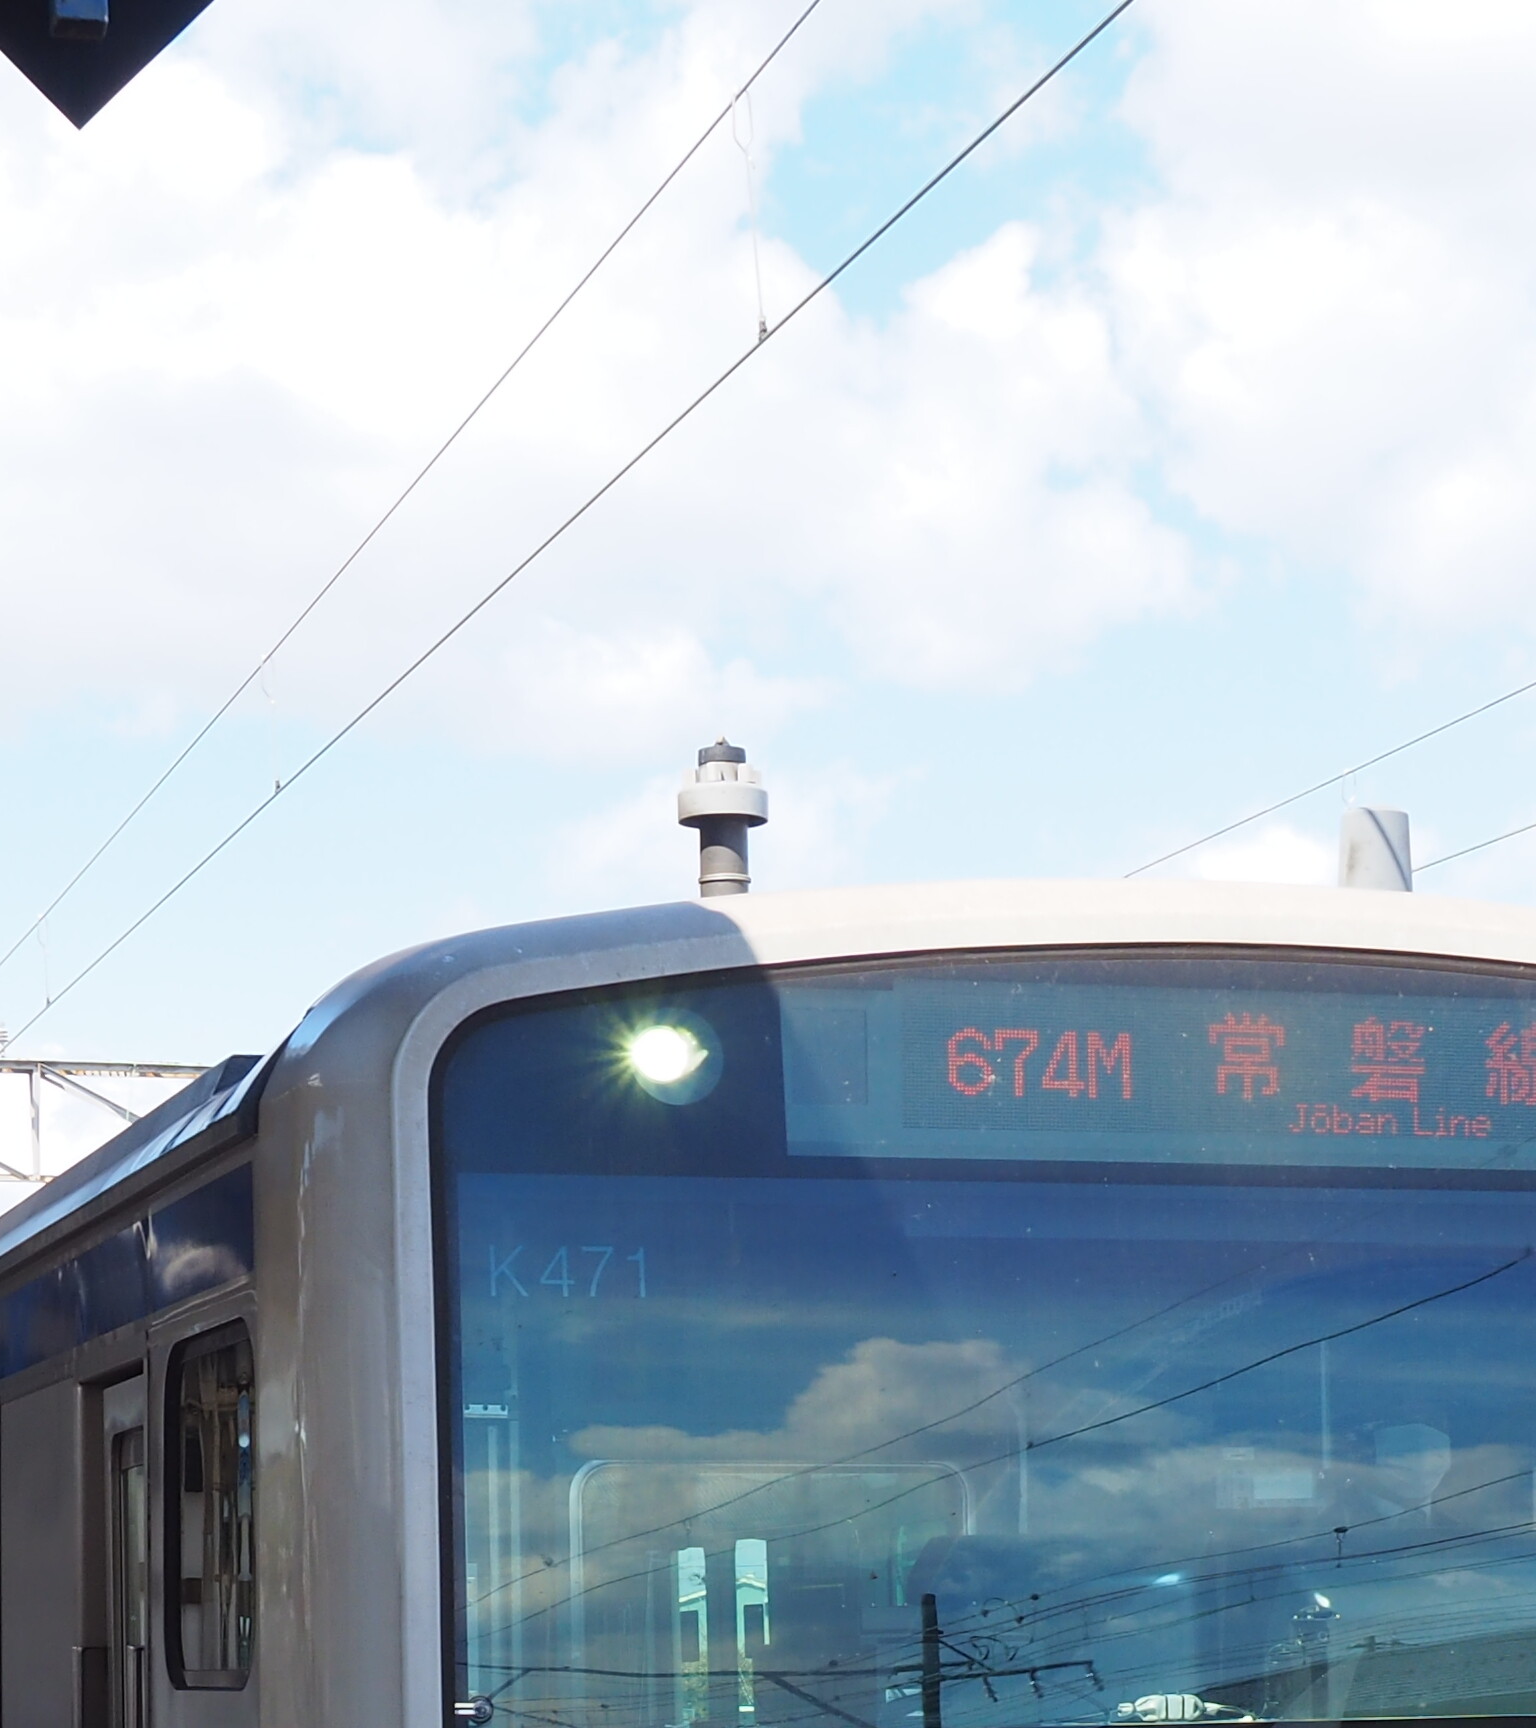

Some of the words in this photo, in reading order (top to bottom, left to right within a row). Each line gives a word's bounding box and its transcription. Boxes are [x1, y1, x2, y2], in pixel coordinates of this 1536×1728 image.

[947, 1027, 1132, 1099] 674M
[1413, 1108, 1491, 1138] Line
[489, 1245, 647, 1298] K471
